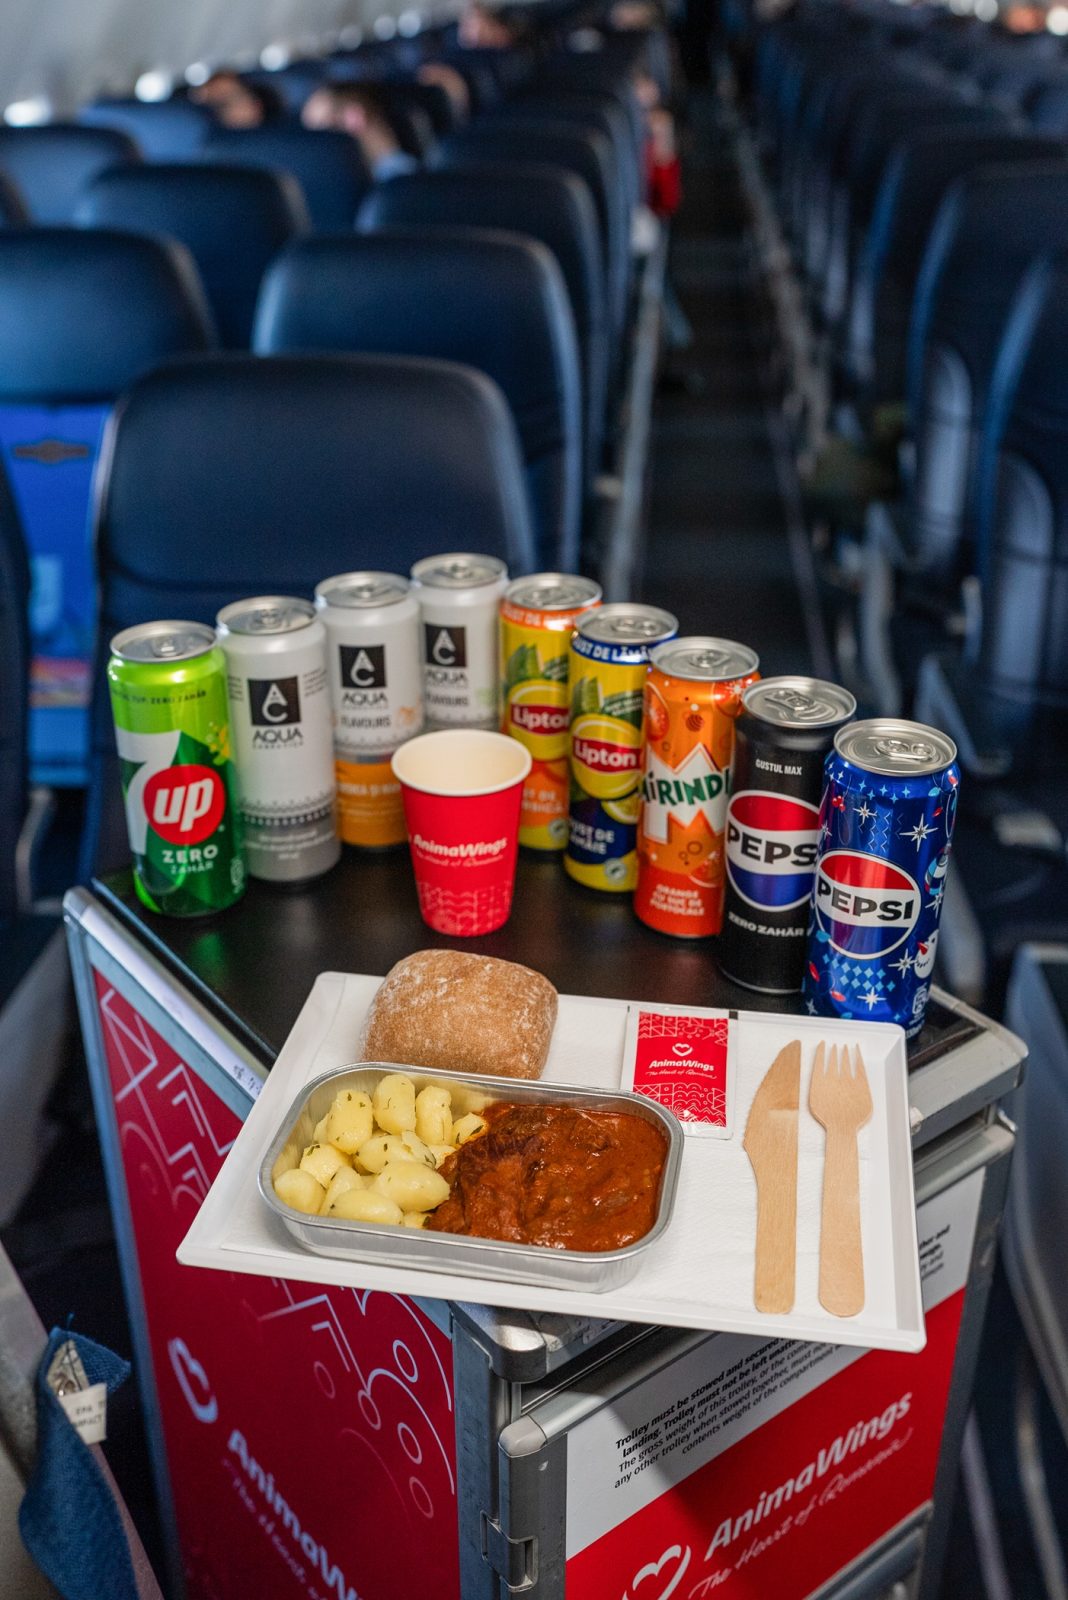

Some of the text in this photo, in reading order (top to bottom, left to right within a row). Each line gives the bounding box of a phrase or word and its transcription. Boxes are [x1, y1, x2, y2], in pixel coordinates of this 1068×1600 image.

[593, 645, 610, 661] DE
[342, 692, 388, 705] AQUA
[252, 726, 304, 744] AQUA
[574, 738, 638, 767] Lipton
[755, 758, 802, 776] GUSTUL MAX
[162, 844, 218, 863] ZERO
[414, 834, 508, 858] AnimaWings
[818, 875, 915, 921] PEPSI
[728, 911, 757, 932] ZERO
[649, 1059, 714, 1072] AnimaWings
[616, 1422, 649, 1449] Trolley
[651, 1405, 676, 1426] must
[677, 1397, 690, 1409] be
[691, 1371, 724, 1400] stowed
[726, 1359, 743, 1377] and
[619, 1456, 636, 1472] The
[638, 1439, 663, 1462] gross
[665, 1416, 696, 1441] weight
[698, 1406, 708, 1420] of
[709, 1396, 727, 1412] this
[759, 1367, 769, 1379] or
[771, 1358, 785, 1371] the
[622, 1428, 661, 1457] landing.
[664, 1405, 696, 1430] Trolley
[697, 1388, 720, 1408] must
[721, 1376, 737, 1392] not
[739, 1368, 751, 1381] be
[752, 1356, 767, 1372] left
[682, 1424, 721, 1454] contents
[722, 1402, 751, 1427] weight
[753, 1393, 763, 1406] of
[764, 1385, 778, 1399] the
[614, 1471, 632, 1488] any
[634, 1453, 659, 1476] other
[661, 1432, 692, 1456] trolley
[693, 1414, 718, 1435] when
[719, 1390, 751, 1418] stowed
[704, 1391, 913, 1562] AnimaWings
[688, 1569, 732, 1599] The
